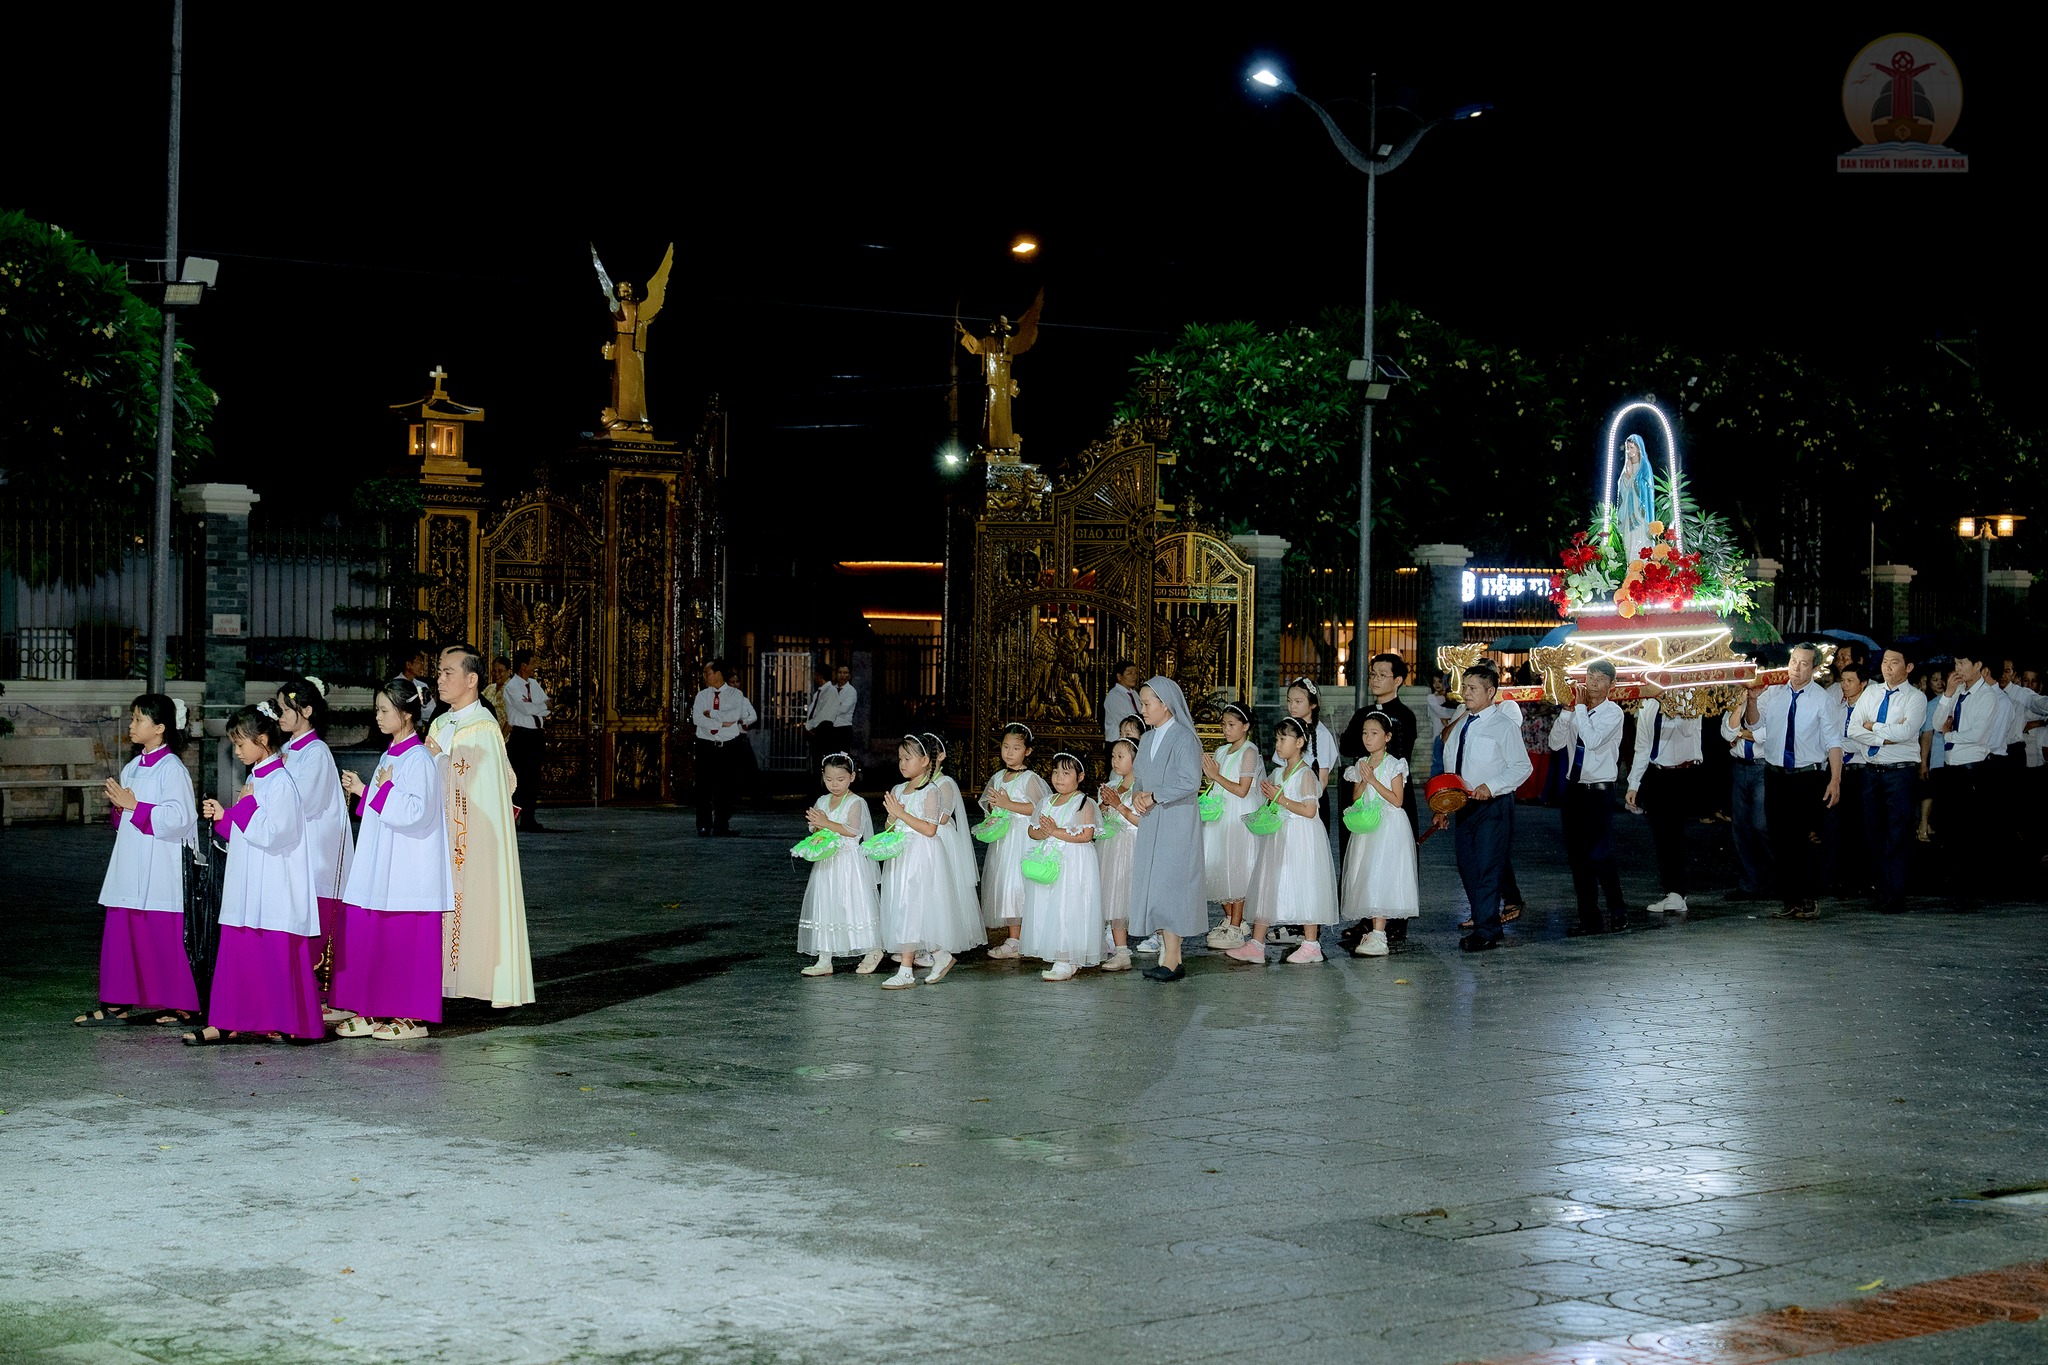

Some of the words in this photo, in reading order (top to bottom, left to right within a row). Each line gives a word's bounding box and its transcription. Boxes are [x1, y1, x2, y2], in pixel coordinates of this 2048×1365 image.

[1075, 526, 1104, 539] GIÁO
[506, 567, 522, 576] EGO
[523, 567, 542, 577] SUM
[1168, 588, 1188, 597] SUM
